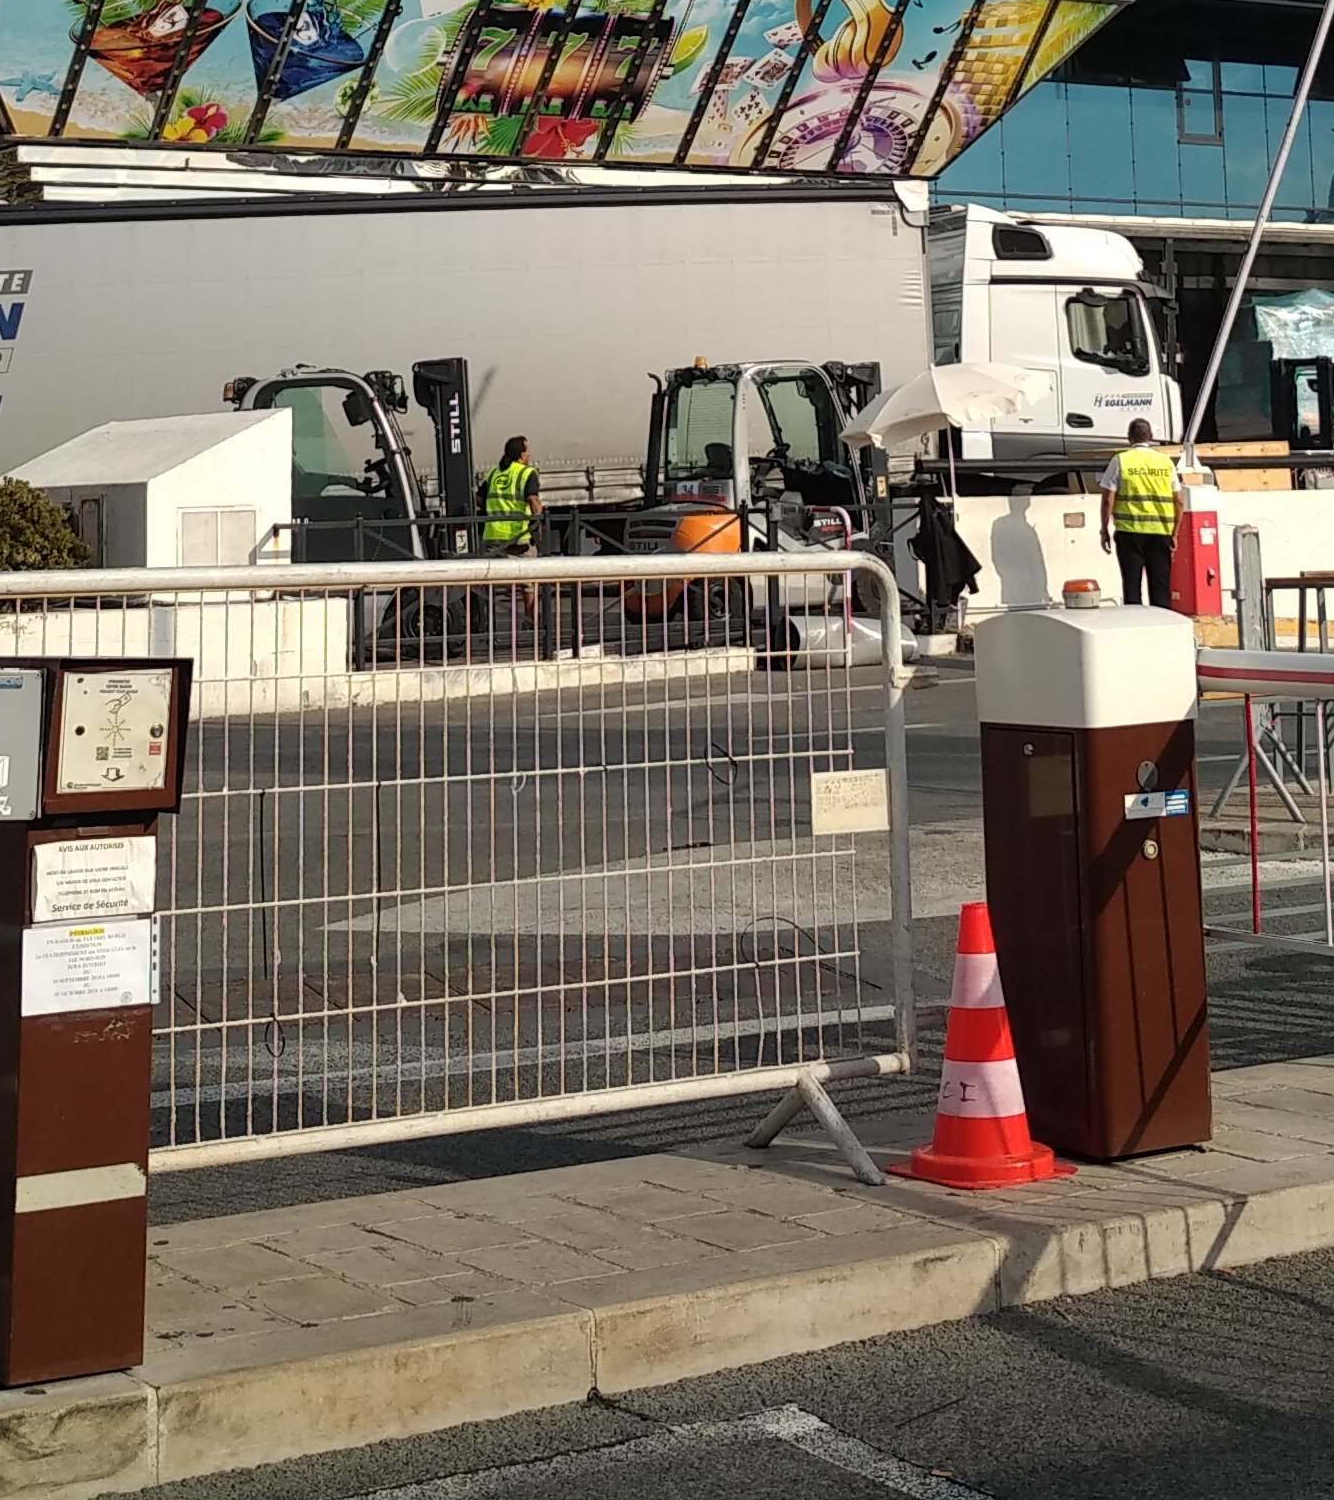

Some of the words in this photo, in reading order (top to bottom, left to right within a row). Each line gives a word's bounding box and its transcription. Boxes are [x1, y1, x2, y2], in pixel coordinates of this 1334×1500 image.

[449, 391, 462, 454] STILL
[681, 483, 694, 495] 34
[813, 516, 843, 527] STILL
[58, 844, 74, 853] AVIS
[74, 843, 89, 851] AUX
[51, 903, 82, 913] Service
[83, 902, 95, 910] de
[95, 898, 129, 909] Sécurité
